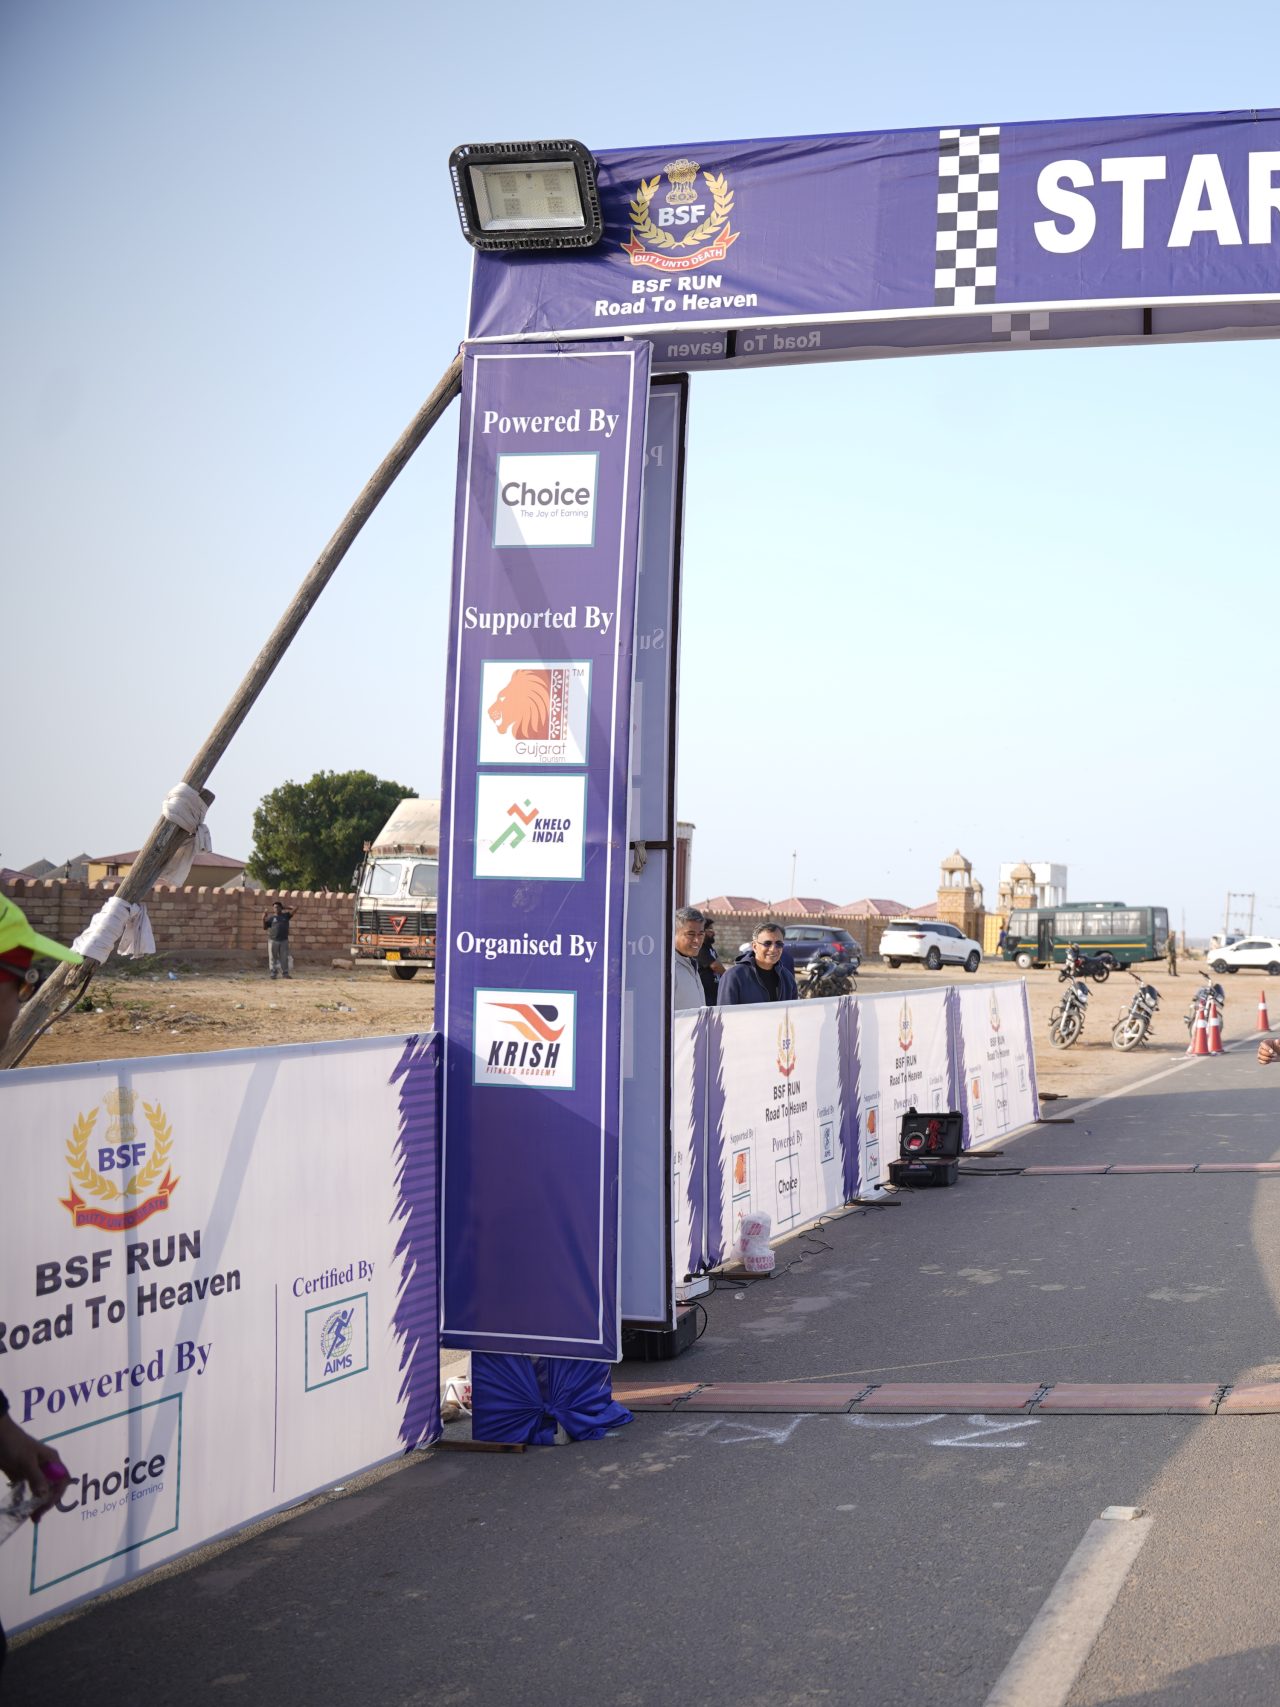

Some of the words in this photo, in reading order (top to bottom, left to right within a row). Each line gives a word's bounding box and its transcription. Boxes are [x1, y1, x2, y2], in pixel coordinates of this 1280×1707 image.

[658, 204, 706, 227] BSF
[634, 254, 661, 267] DUTY
[661, 260, 690, 268] UNTO
[691, 249, 723, 265] DEATH
[631, 278, 672, 294] BSF
[677, 275, 722, 291] RUN
[594, 298, 646, 316] Road
[651, 296, 676, 312] To
[682, 293, 758, 311] Heaven
[481, 409, 581, 434] Powered
[588, 408, 620, 438] By
[501, 481, 590, 507] Choice
[520, 509, 534, 518] The
[536, 509, 549, 519] Joy
[550, 508, 559, 518] of
[560, 509, 589, 519] Earning
[464, 606, 577, 636] Supported
[584, 606, 614, 635] By
[571, 668, 585, 677] TM
[515, 741, 567, 758] Gujarat
[534, 818, 571, 831] KHELO
[532, 831, 564, 843] INDIA
[456, 931, 562, 960] Organised
[569, 934, 598, 963] By
[488, 1040, 560, 1069] KRISH
[485, 1066, 517, 1075] FITNESS
[520, 1068, 556, 1077] ACADEMY
[773, 1084, 786, 1100] BSF
[787, 1081, 801, 1096] RUN
[765, 1105, 780, 1122] Road
[781, 1104, 788, 1118] To
[789, 1101, 808, 1115] Heaven
[772, 1133, 796, 1152] Powered
[796, 1130, 803, 1147] By
[98, 1142, 146, 1172] BSF
[778, 1176, 798, 1195] Choice
[36, 1248, 113, 1297] BSF
[126, 1230, 201, 1275] RUN
[292, 1263, 354, 1298] Certified
[358, 1259, 375, 1282] By
[85, 1295, 125, 1330] To
[137, 1268, 241, 1317] Heaven
[323, 1354, 353, 1377] AIMS
[20, 1348, 165, 1424] Powered
[175, 1340, 213, 1376] By
[54, 1453, 166, 1513] Choice
[81, 1505, 98, 1521] The
[100, 1498, 118, 1515] Joy
[118, 1491, 130, 1505] of
[131, 1481, 164, 1501] Earning
